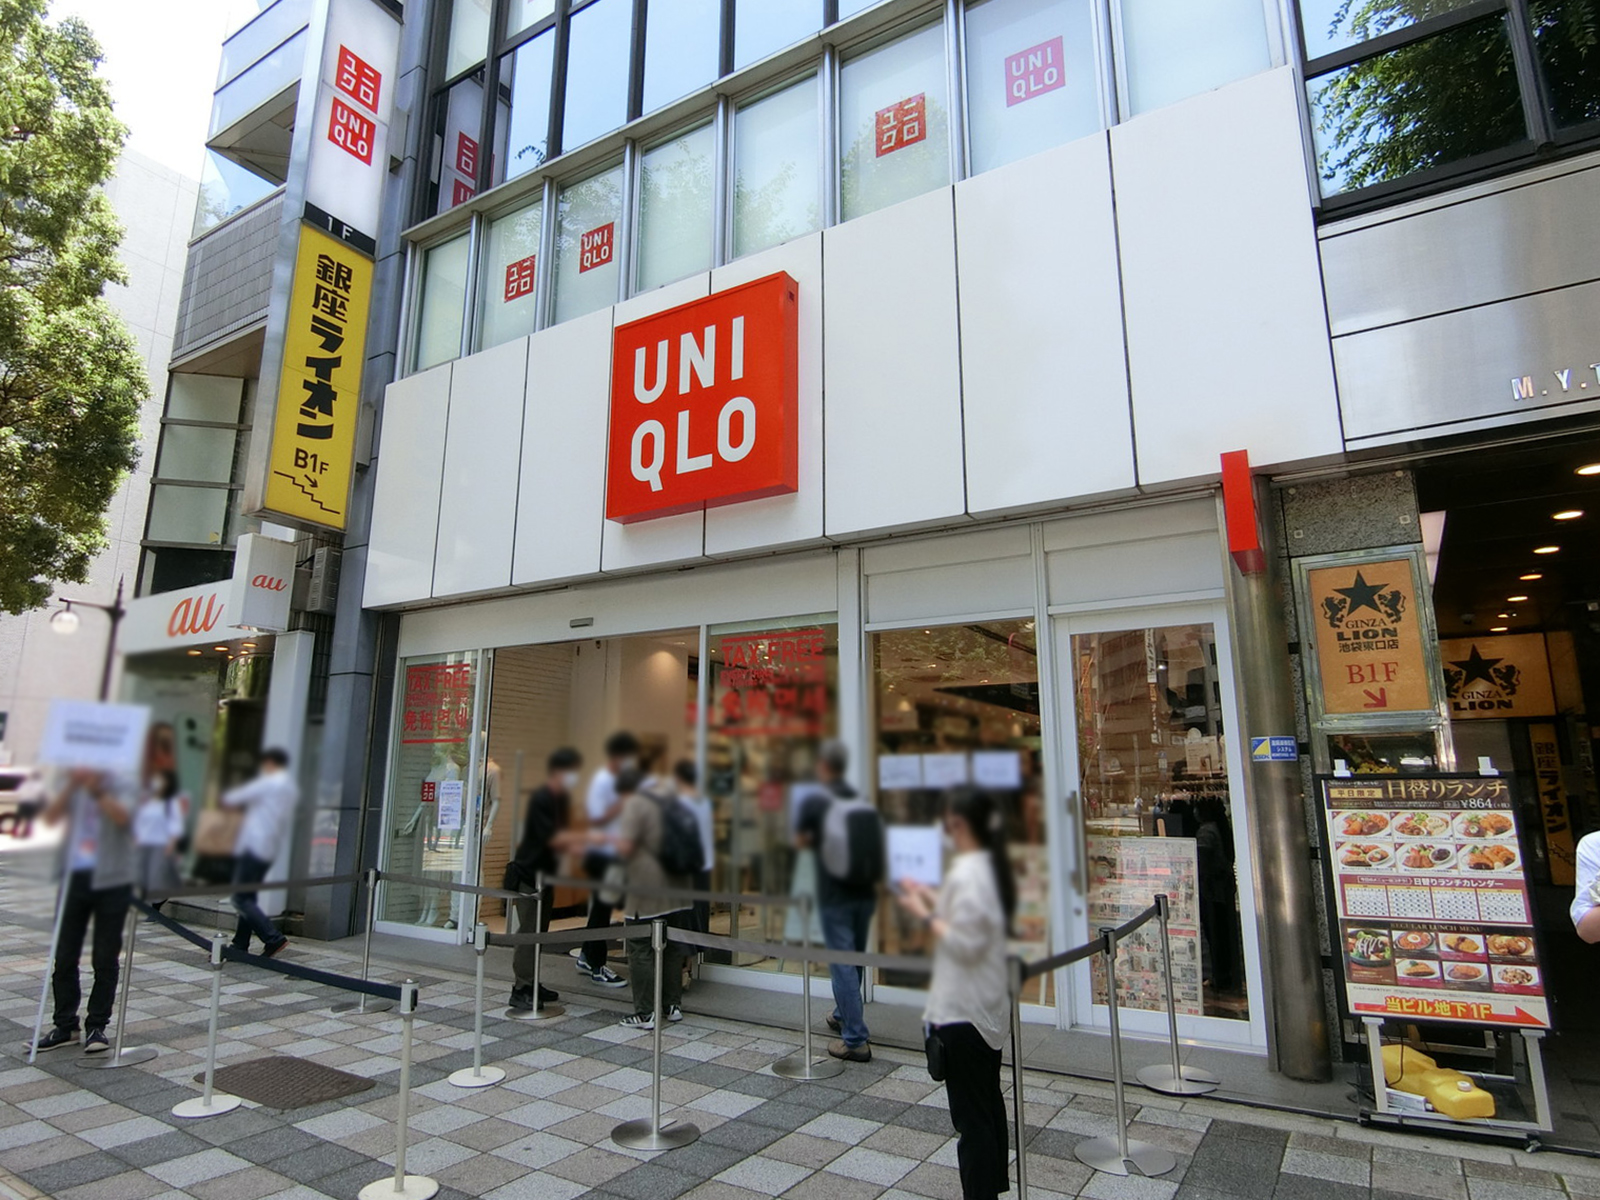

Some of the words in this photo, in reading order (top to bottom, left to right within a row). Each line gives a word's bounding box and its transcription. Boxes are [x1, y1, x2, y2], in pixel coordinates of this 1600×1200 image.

[344, 54, 375, 89] ユニ
[1011, 46, 1053, 77] UNI
[340, 71, 374, 106] クロ
[1012, 66, 1058, 99] QLO
[336, 105, 368, 139] UNI
[882, 101, 919, 130] ユニ
[334, 124, 368, 157] QLO
[881, 121, 919, 150] クロ
[326, 215, 353, 240] 1F
[583, 229, 608, 250] UNI
[583, 245, 609, 268] QLO
[509, 260, 531, 281] ユニ
[507, 277, 531, 297] クロ
[296, 252, 354, 440] 銀座ライオン
[634, 315, 745, 405] UNI
[630, 396, 756, 492] QLO
[293, 447, 329, 475] B1F
[252, 574, 288, 592] au
[167, 592, 225, 638] au
[1345, 618, 1387, 630] GINZA
[1337, 627, 1398, 642] LION
[1339, 639, 1399, 653] 池袋東口店
[721, 644, 760, 668] TAX
[767, 637, 826, 666] FREE
[407, 673, 431, 691] TAX
[434, 669, 470, 689] FREE
[1345, 661, 1399, 685] B1F
[1453, 699, 1514, 712] LION
[1461, 690, 1503, 700] GINZA
[1387, 778, 1508, 799] 日替りランチ
[1461, 797, 1493, 809] ¥864
[1413, 877, 1504, 888] 日替りランチカレンダー
[1390, 922, 1428, 931] REGULAR
[1429, 924, 1457, 932] LUNCH
[1385, 995, 1492, 1020] 当ビル地下1F
